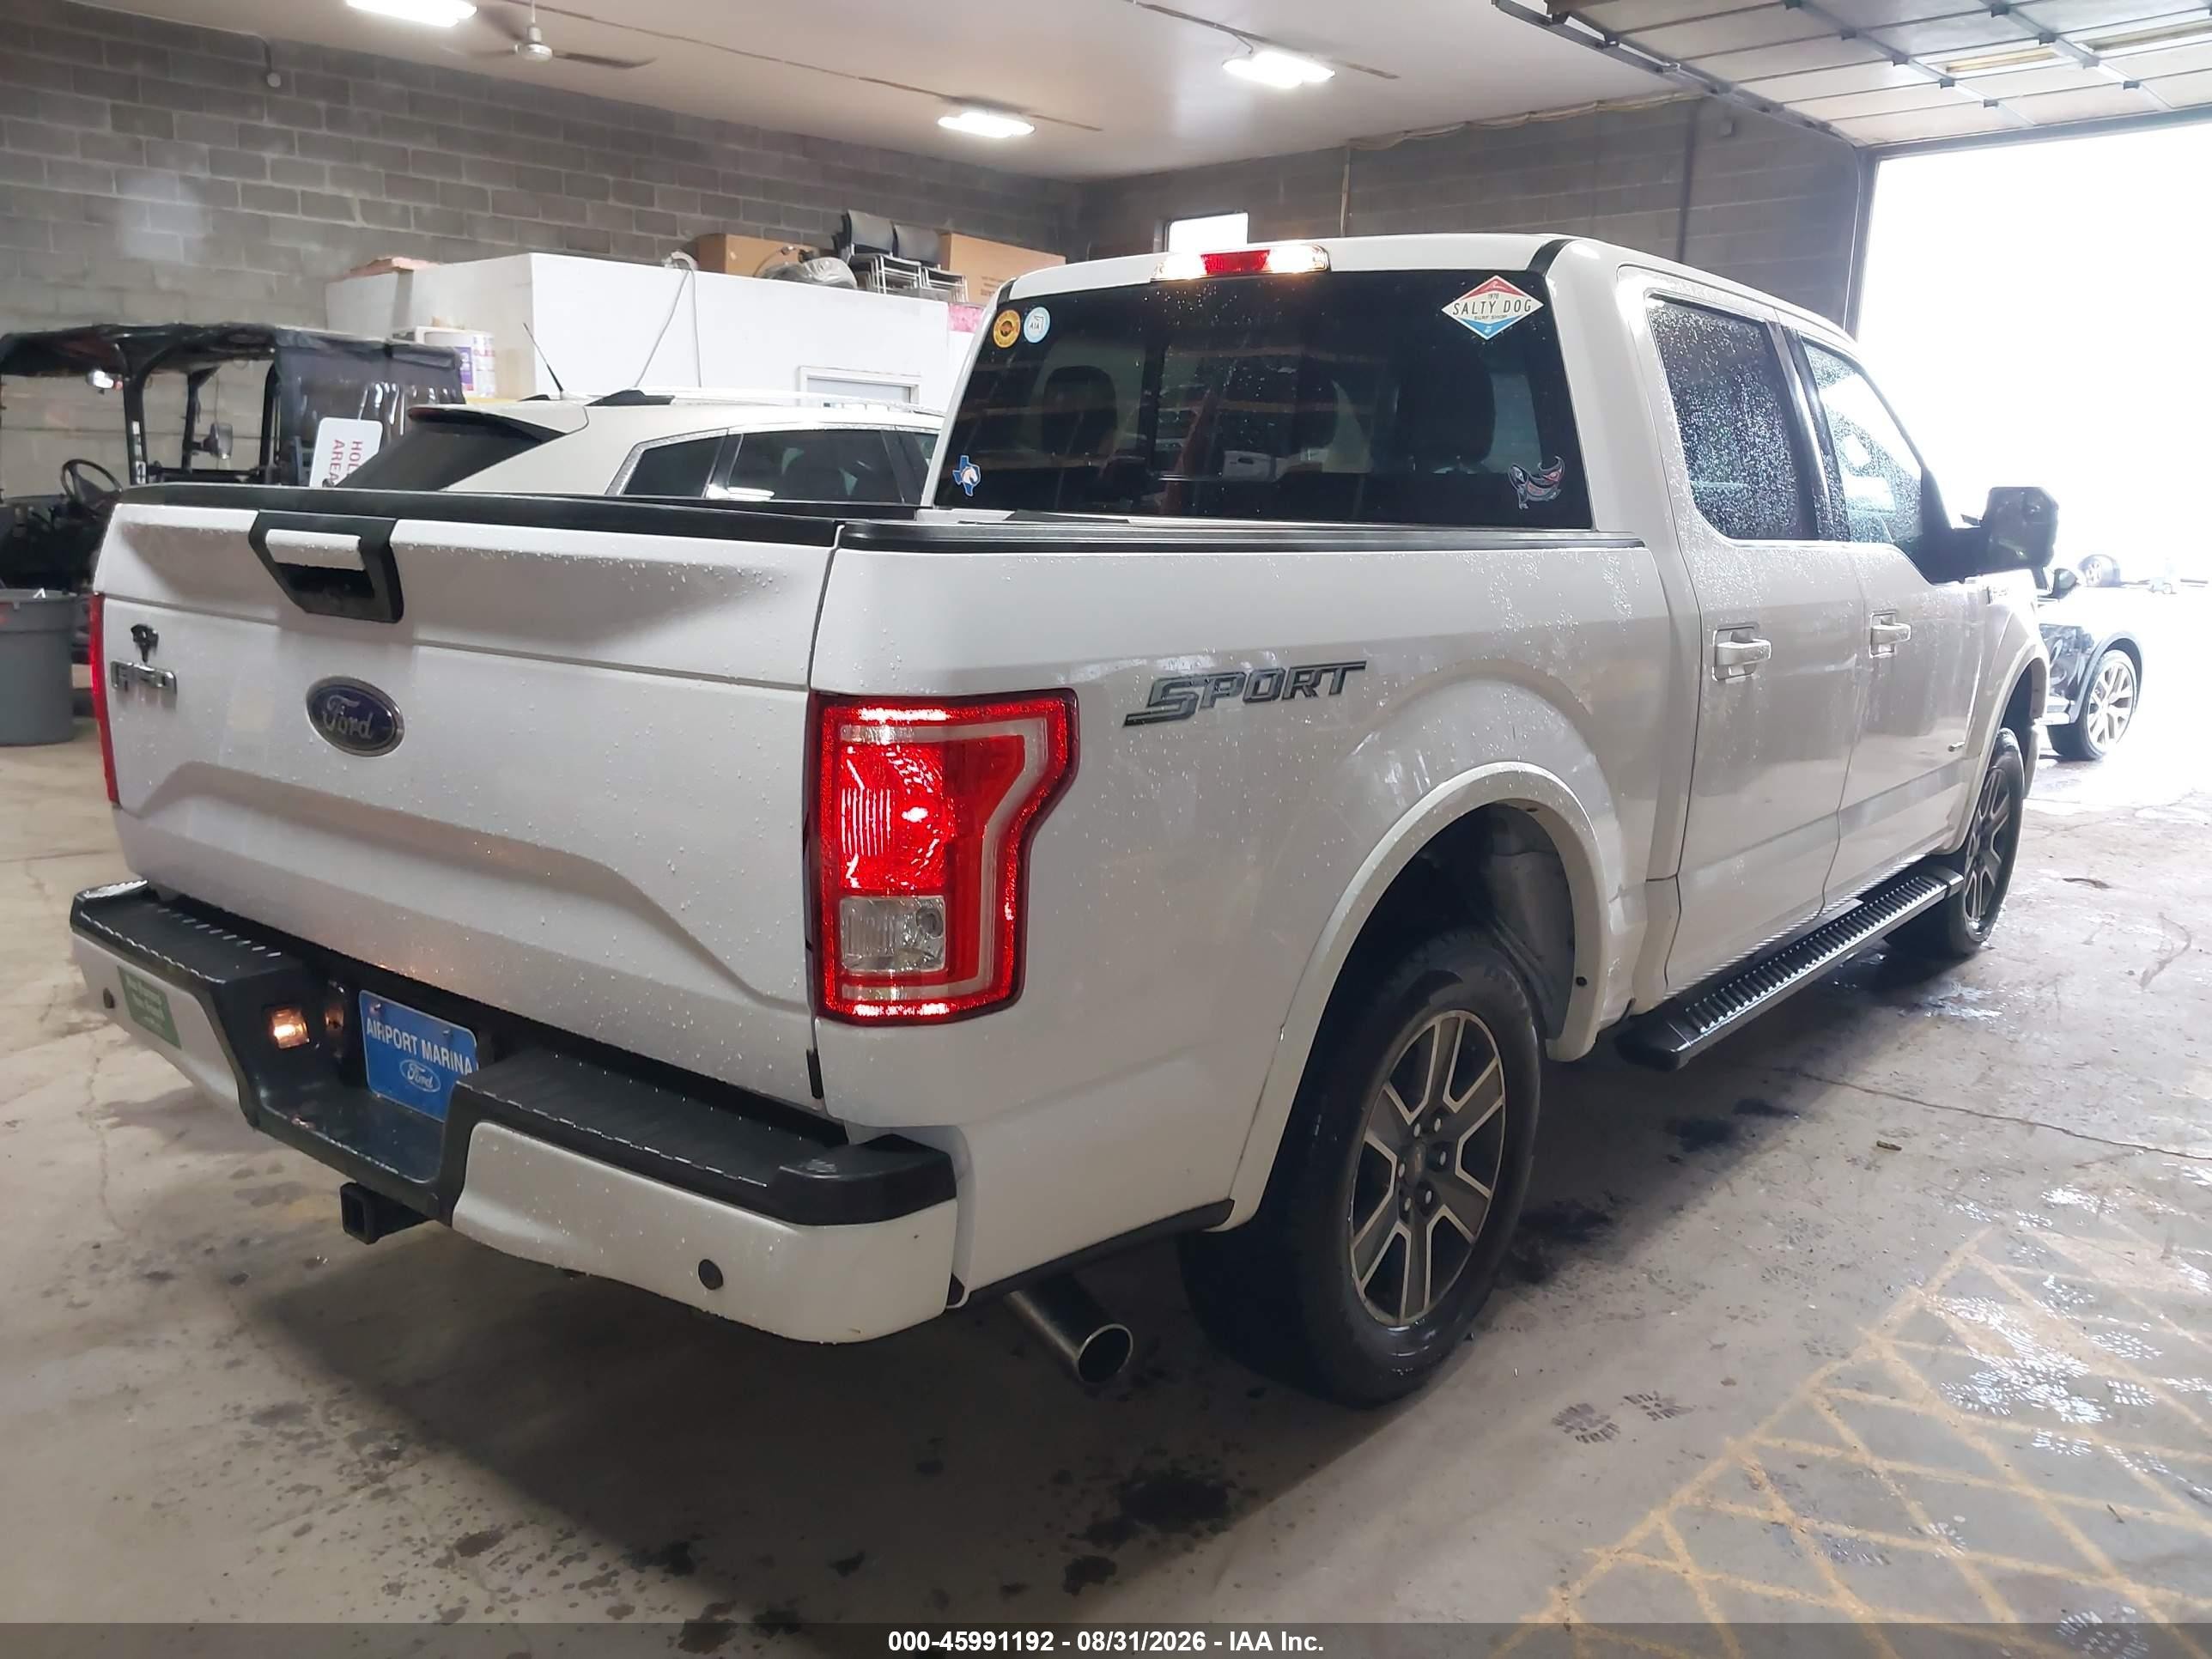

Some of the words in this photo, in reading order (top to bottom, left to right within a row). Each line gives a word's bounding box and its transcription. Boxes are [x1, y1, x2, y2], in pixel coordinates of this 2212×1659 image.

[1453, 301, 1496, 316] SALTY
[1504, 299, 1532, 313] DOG
[329, 439, 345, 482] AREA
[1122, 660, 1367, 727] SPORT
[323, 694, 374, 739] Ford
[367, 1018, 418, 1055] AIRPORT
[421, 1039, 473, 1076] MARINA
[407, 1063, 434, 1090] Ford
